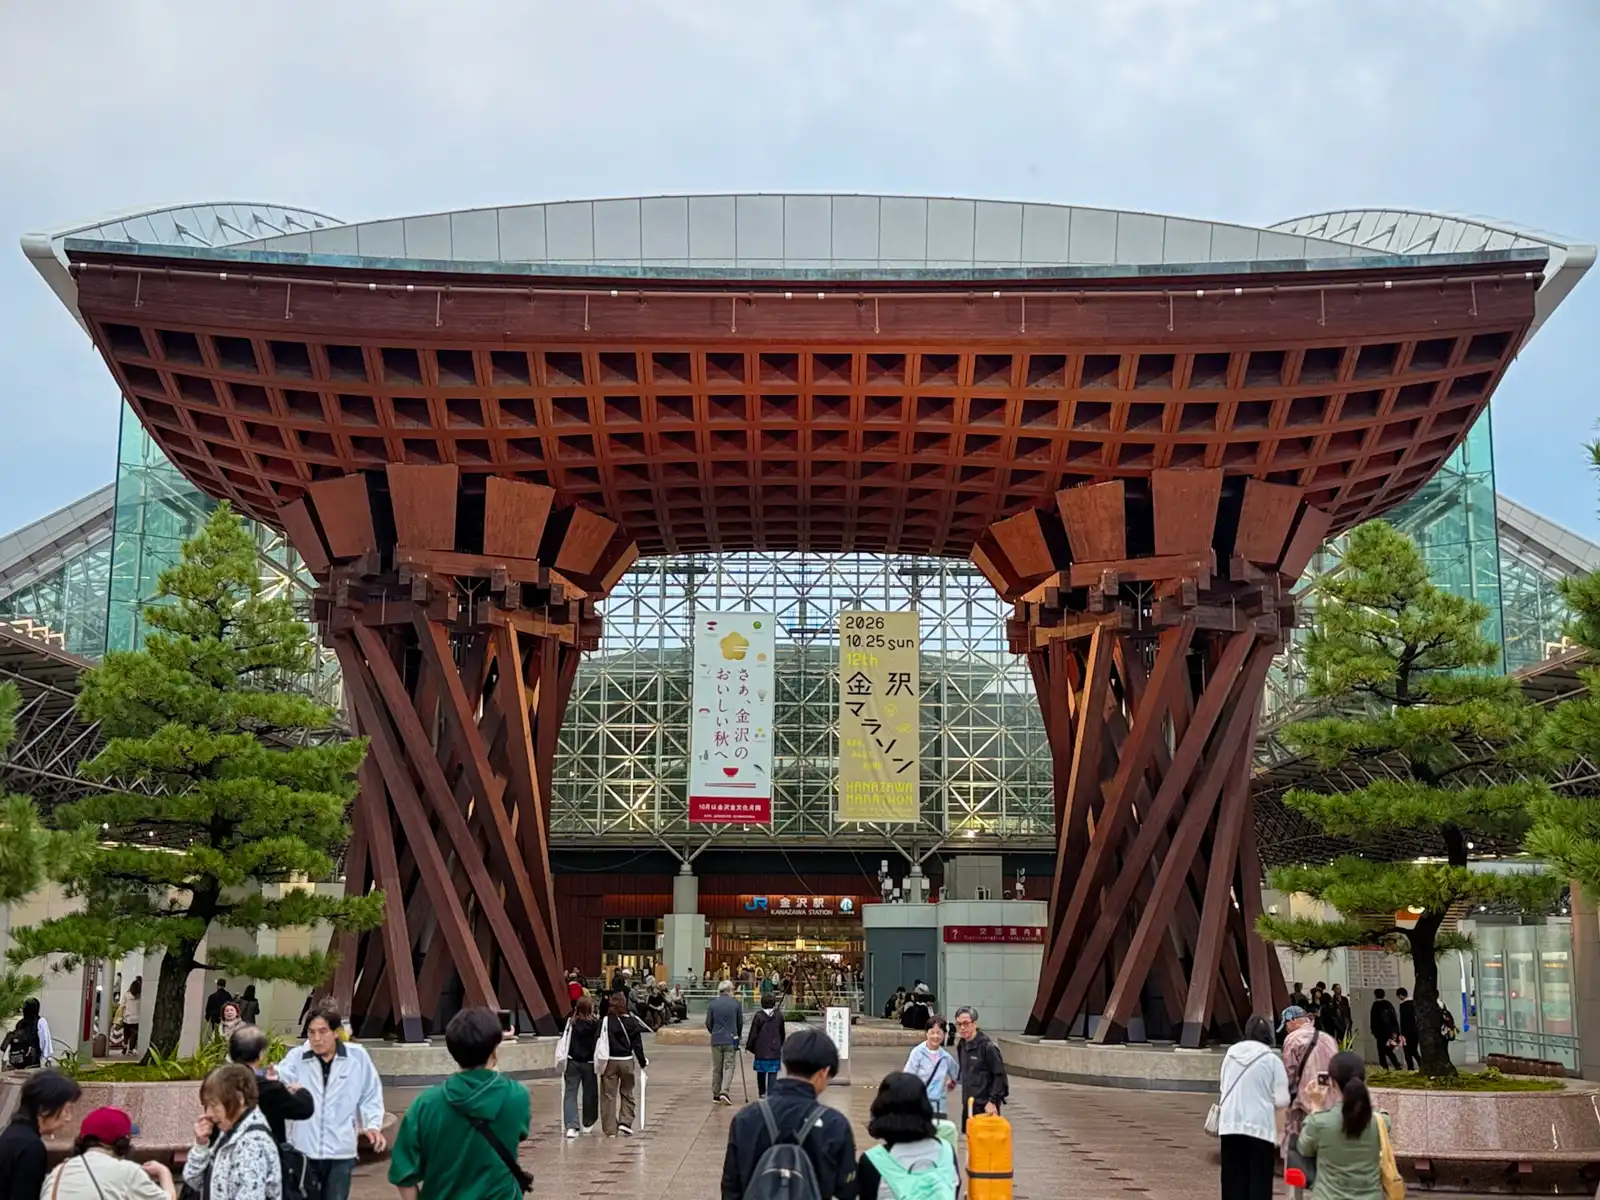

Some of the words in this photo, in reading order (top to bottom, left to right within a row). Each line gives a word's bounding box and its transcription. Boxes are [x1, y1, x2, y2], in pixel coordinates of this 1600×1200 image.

[845, 616, 885, 630] 2026
[845, 634, 885, 648] 10.25
[887, 638, 915, 651] sun
[846, 671, 915, 696] 金沢
[713, 667, 731, 759] おいしい秋へ
[845, 701, 915, 774] マラソン
[745, 896, 768, 911] JR
[779, 896, 825, 908] 金沢駅
